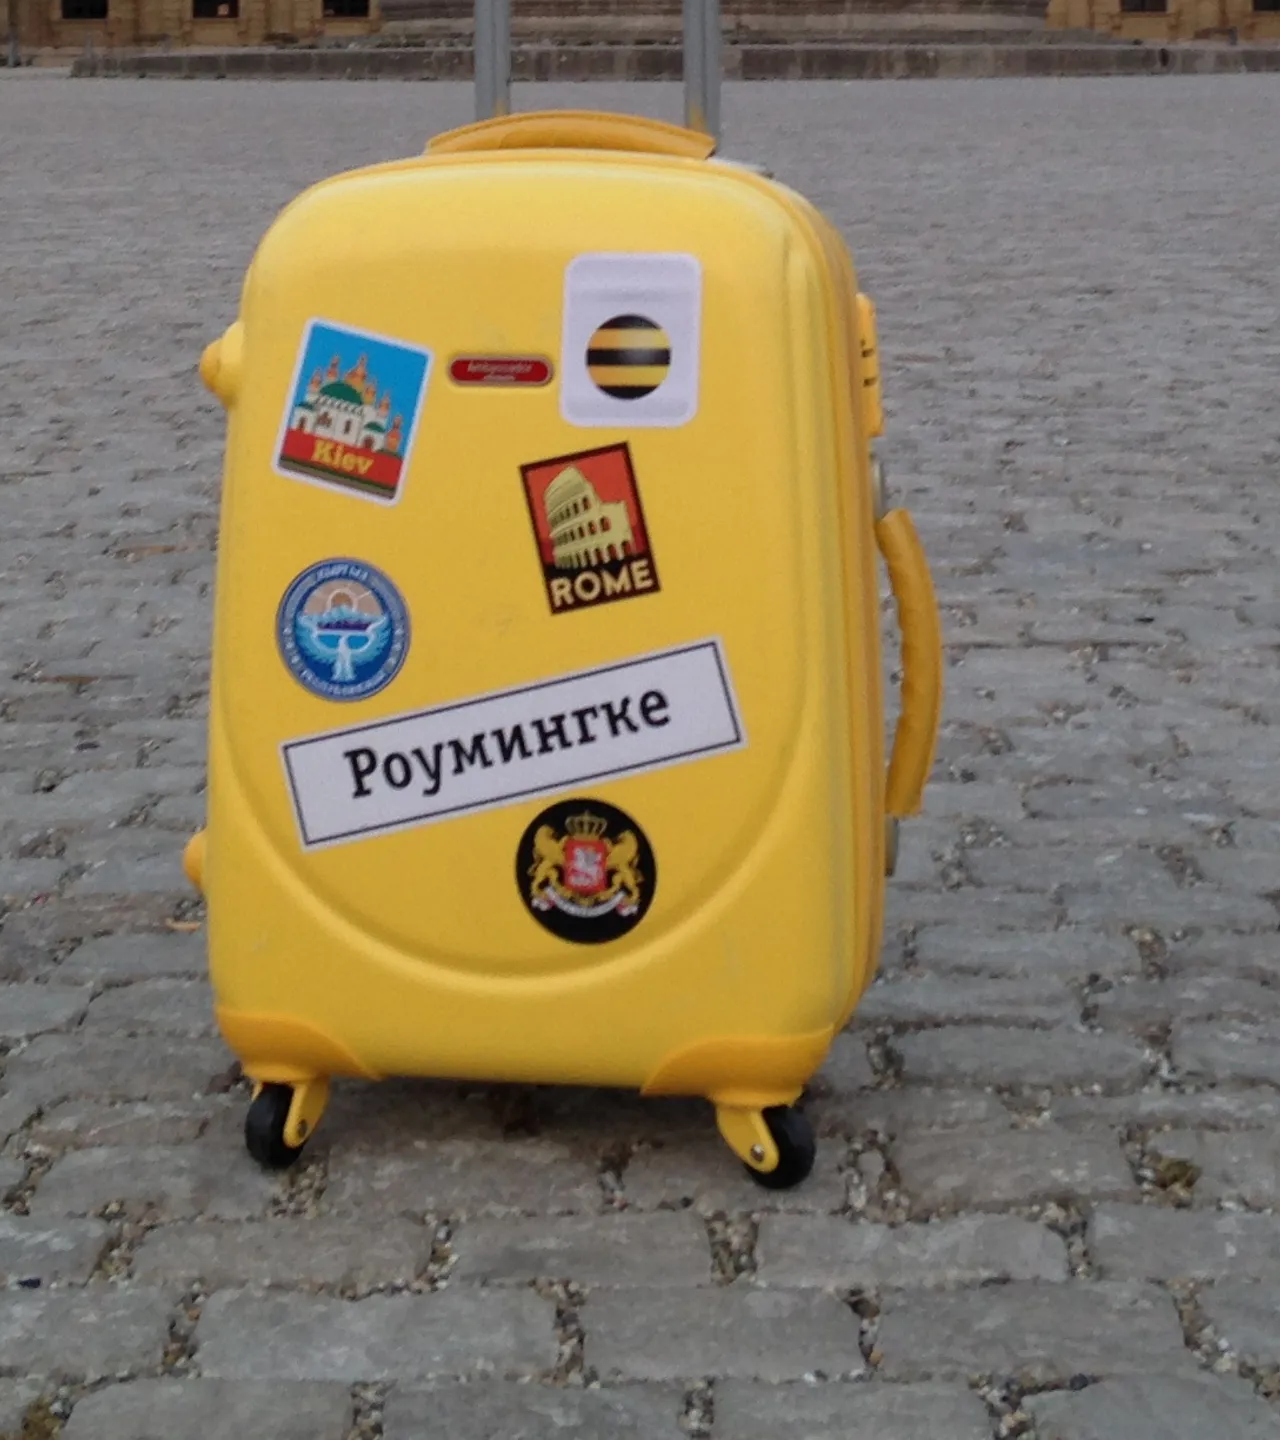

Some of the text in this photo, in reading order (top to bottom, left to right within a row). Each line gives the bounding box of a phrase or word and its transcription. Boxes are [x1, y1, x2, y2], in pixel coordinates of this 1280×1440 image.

[310, 439, 375, 475] Kiev
[550, 558, 653, 608] ROME
[344, 689, 671, 799] Роумингке
